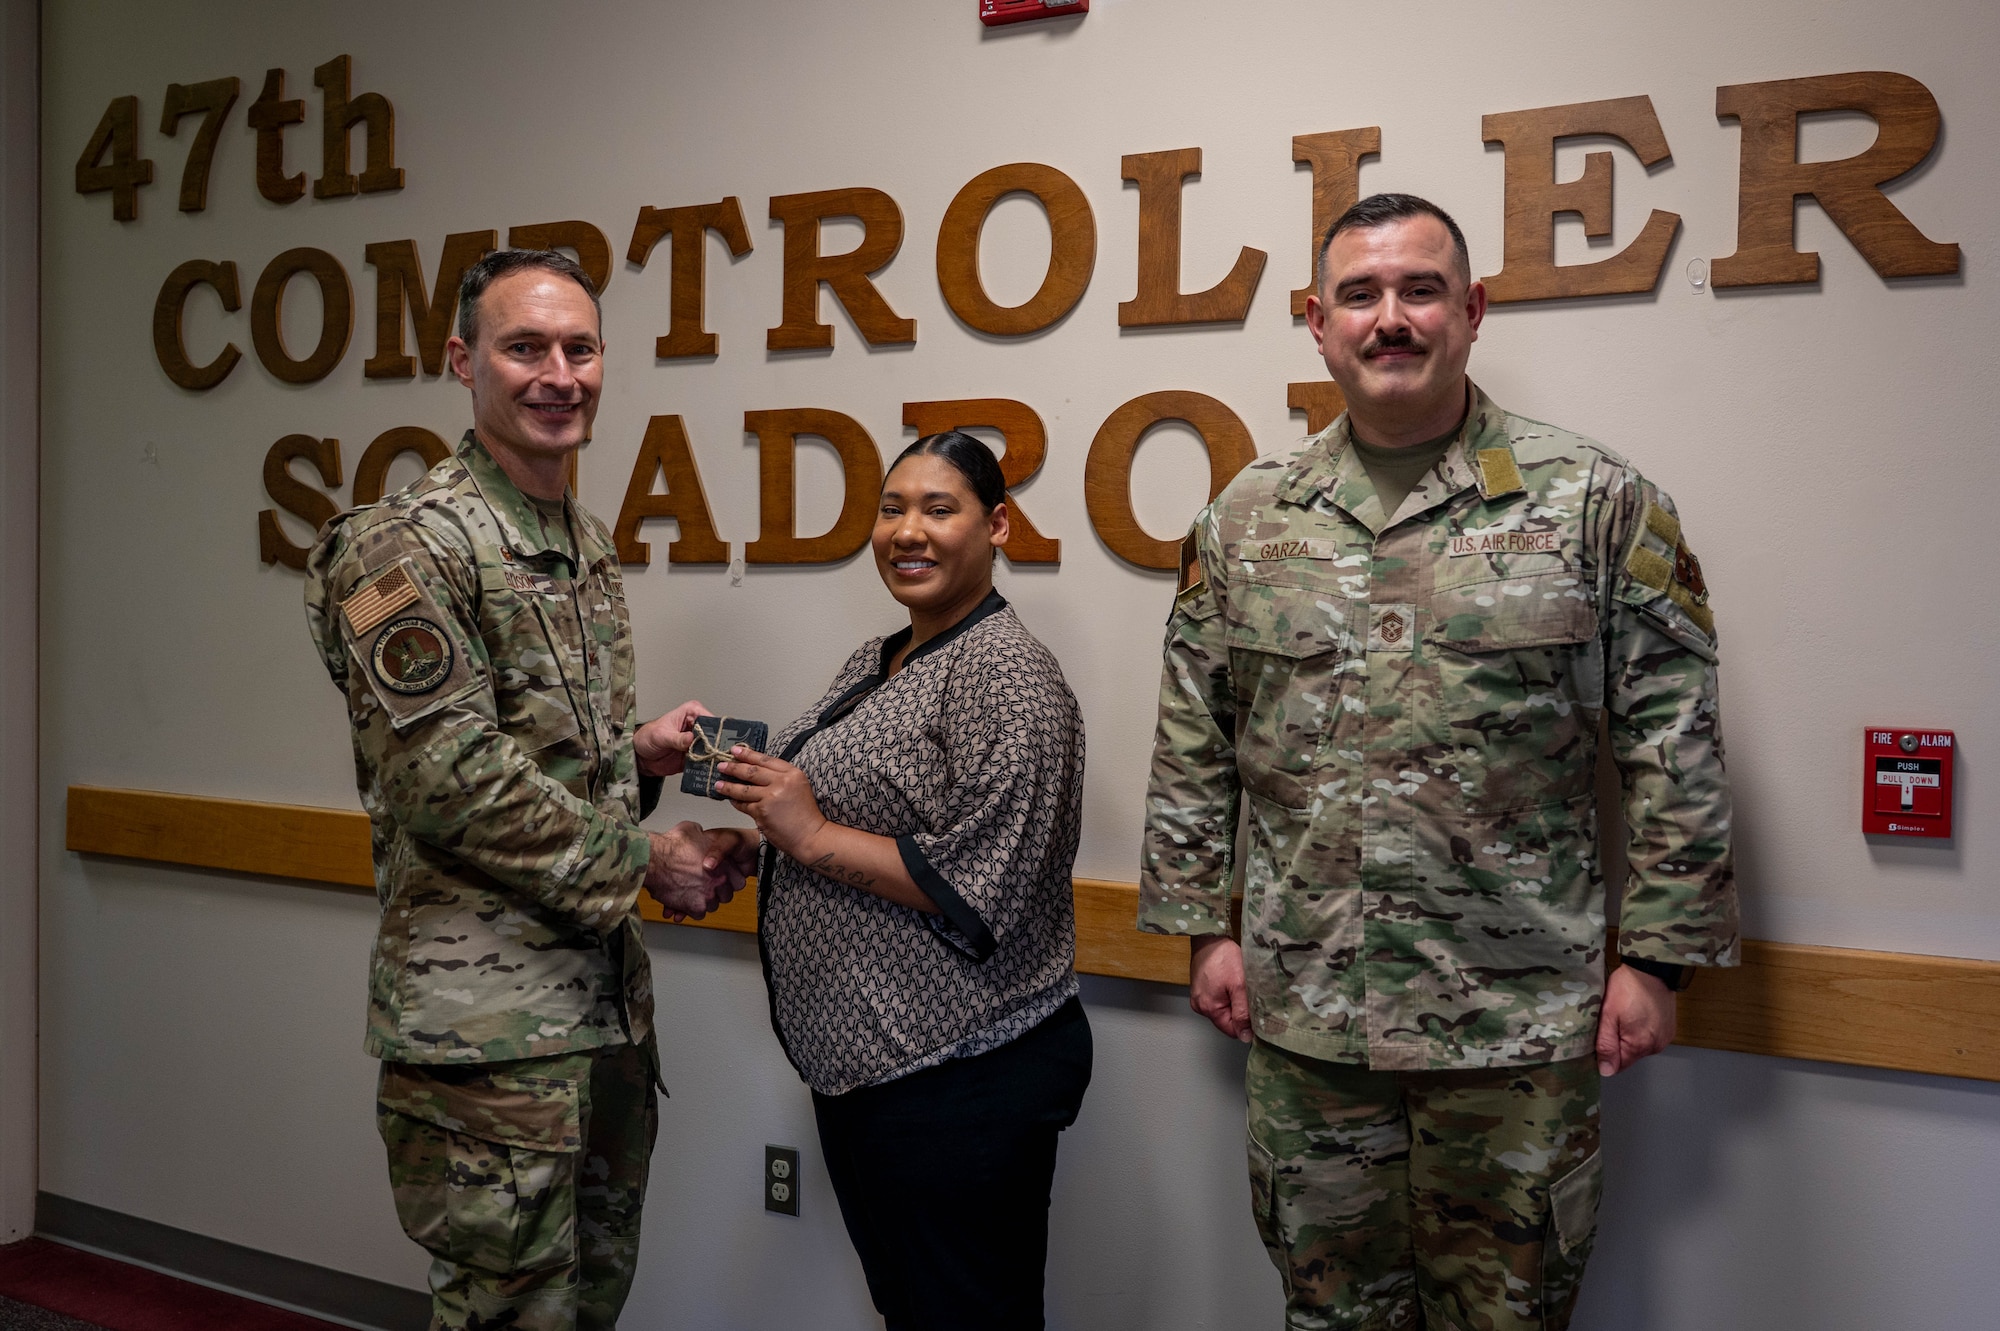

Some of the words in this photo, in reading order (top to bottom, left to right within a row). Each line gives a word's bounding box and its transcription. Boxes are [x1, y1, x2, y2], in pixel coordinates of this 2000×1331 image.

[75, 54, 405, 222] 47th
[258, 381, 1348, 571] SADRO
[1260, 540, 1310, 559] GARZA
[1453, 537, 1477, 553] U.S.
[1480, 535, 1507, 551] AIR
[1509, 532, 1554, 550] FORCE
[1873, 732, 1892, 745] FIRE
[1920, 735, 1952, 747] ALARM
[1897, 762, 1920, 771] PUSH
[1883, 774, 1903, 783] PULL
[1909, 776, 1933, 785] DOWN
